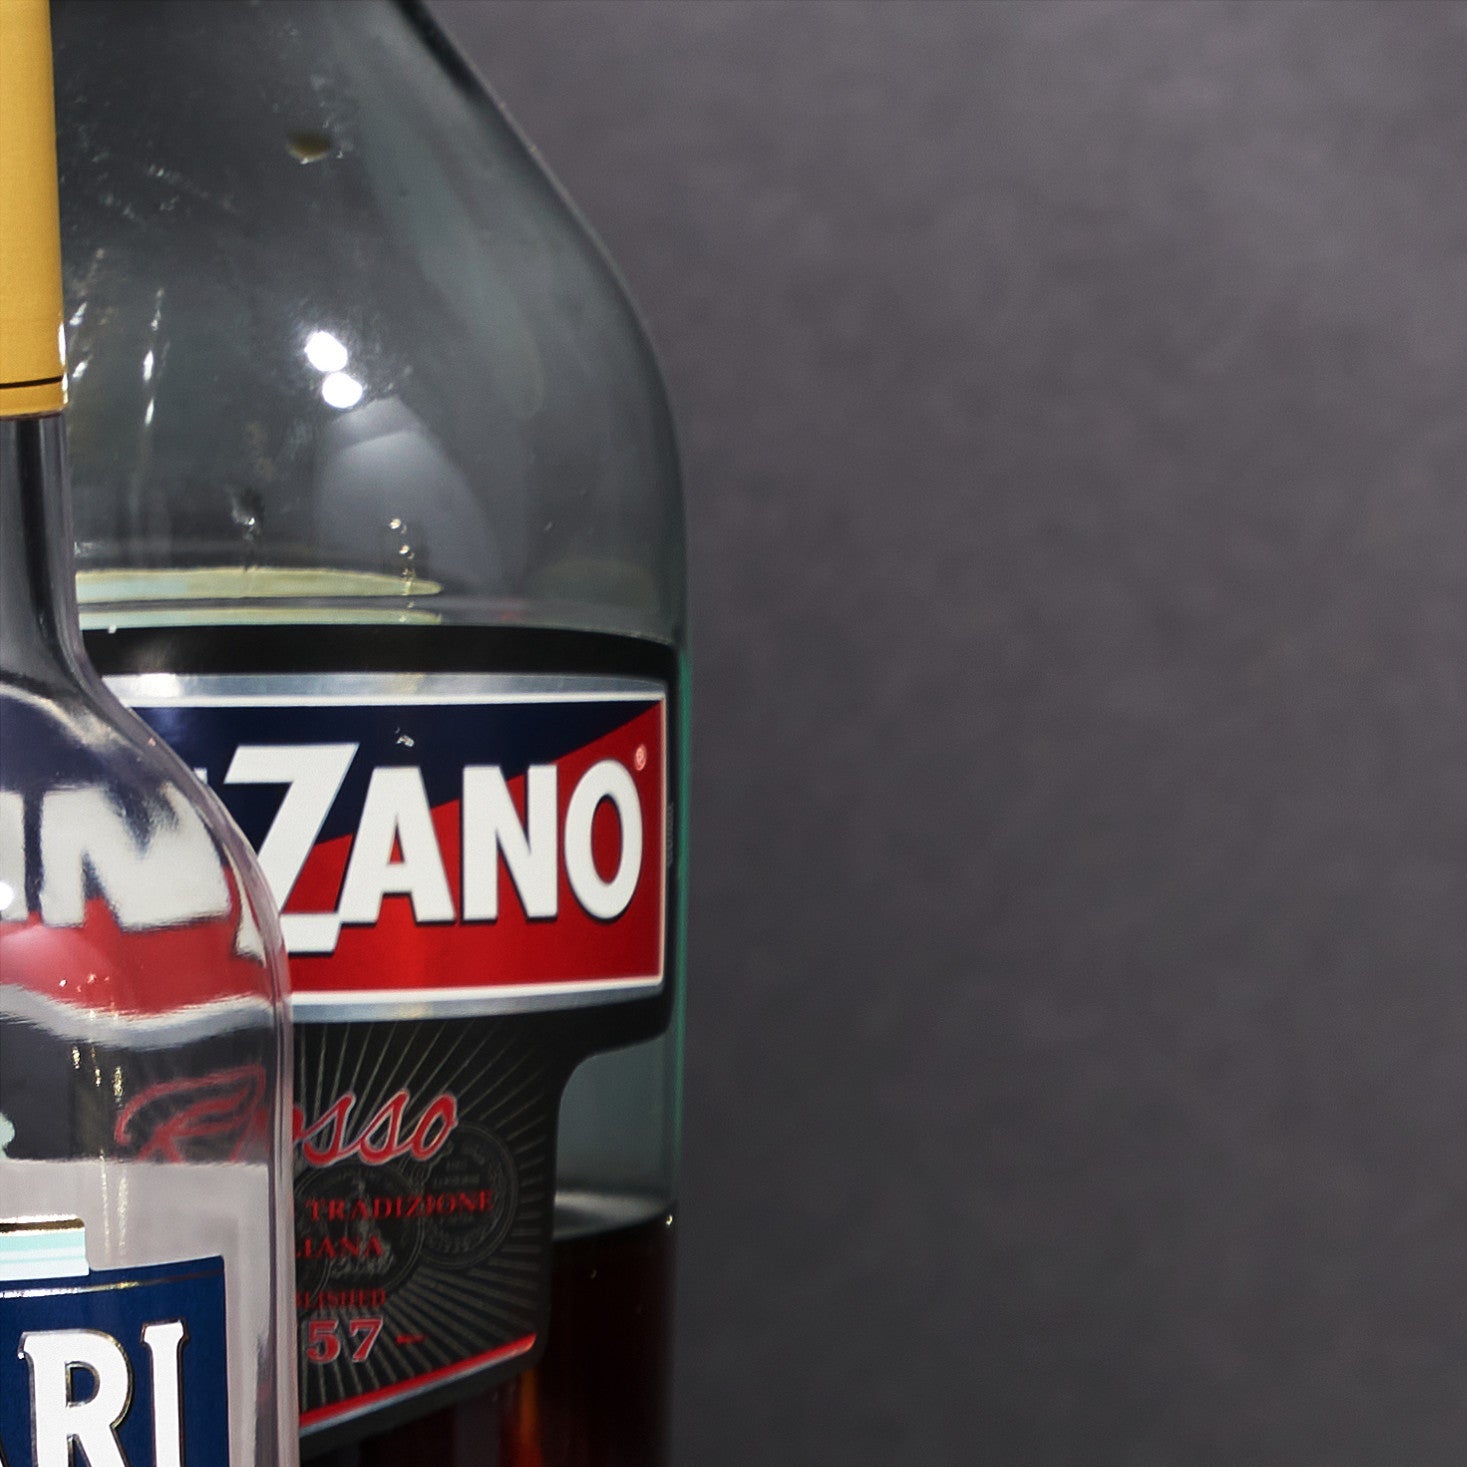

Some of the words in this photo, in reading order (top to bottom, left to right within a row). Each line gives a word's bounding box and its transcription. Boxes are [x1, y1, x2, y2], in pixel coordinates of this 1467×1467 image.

[305, 1190, 494, 1222] TRADIZIONE
[296, 1234, 384, 1258] IANA
[307, 1318, 383, 1363] 57
